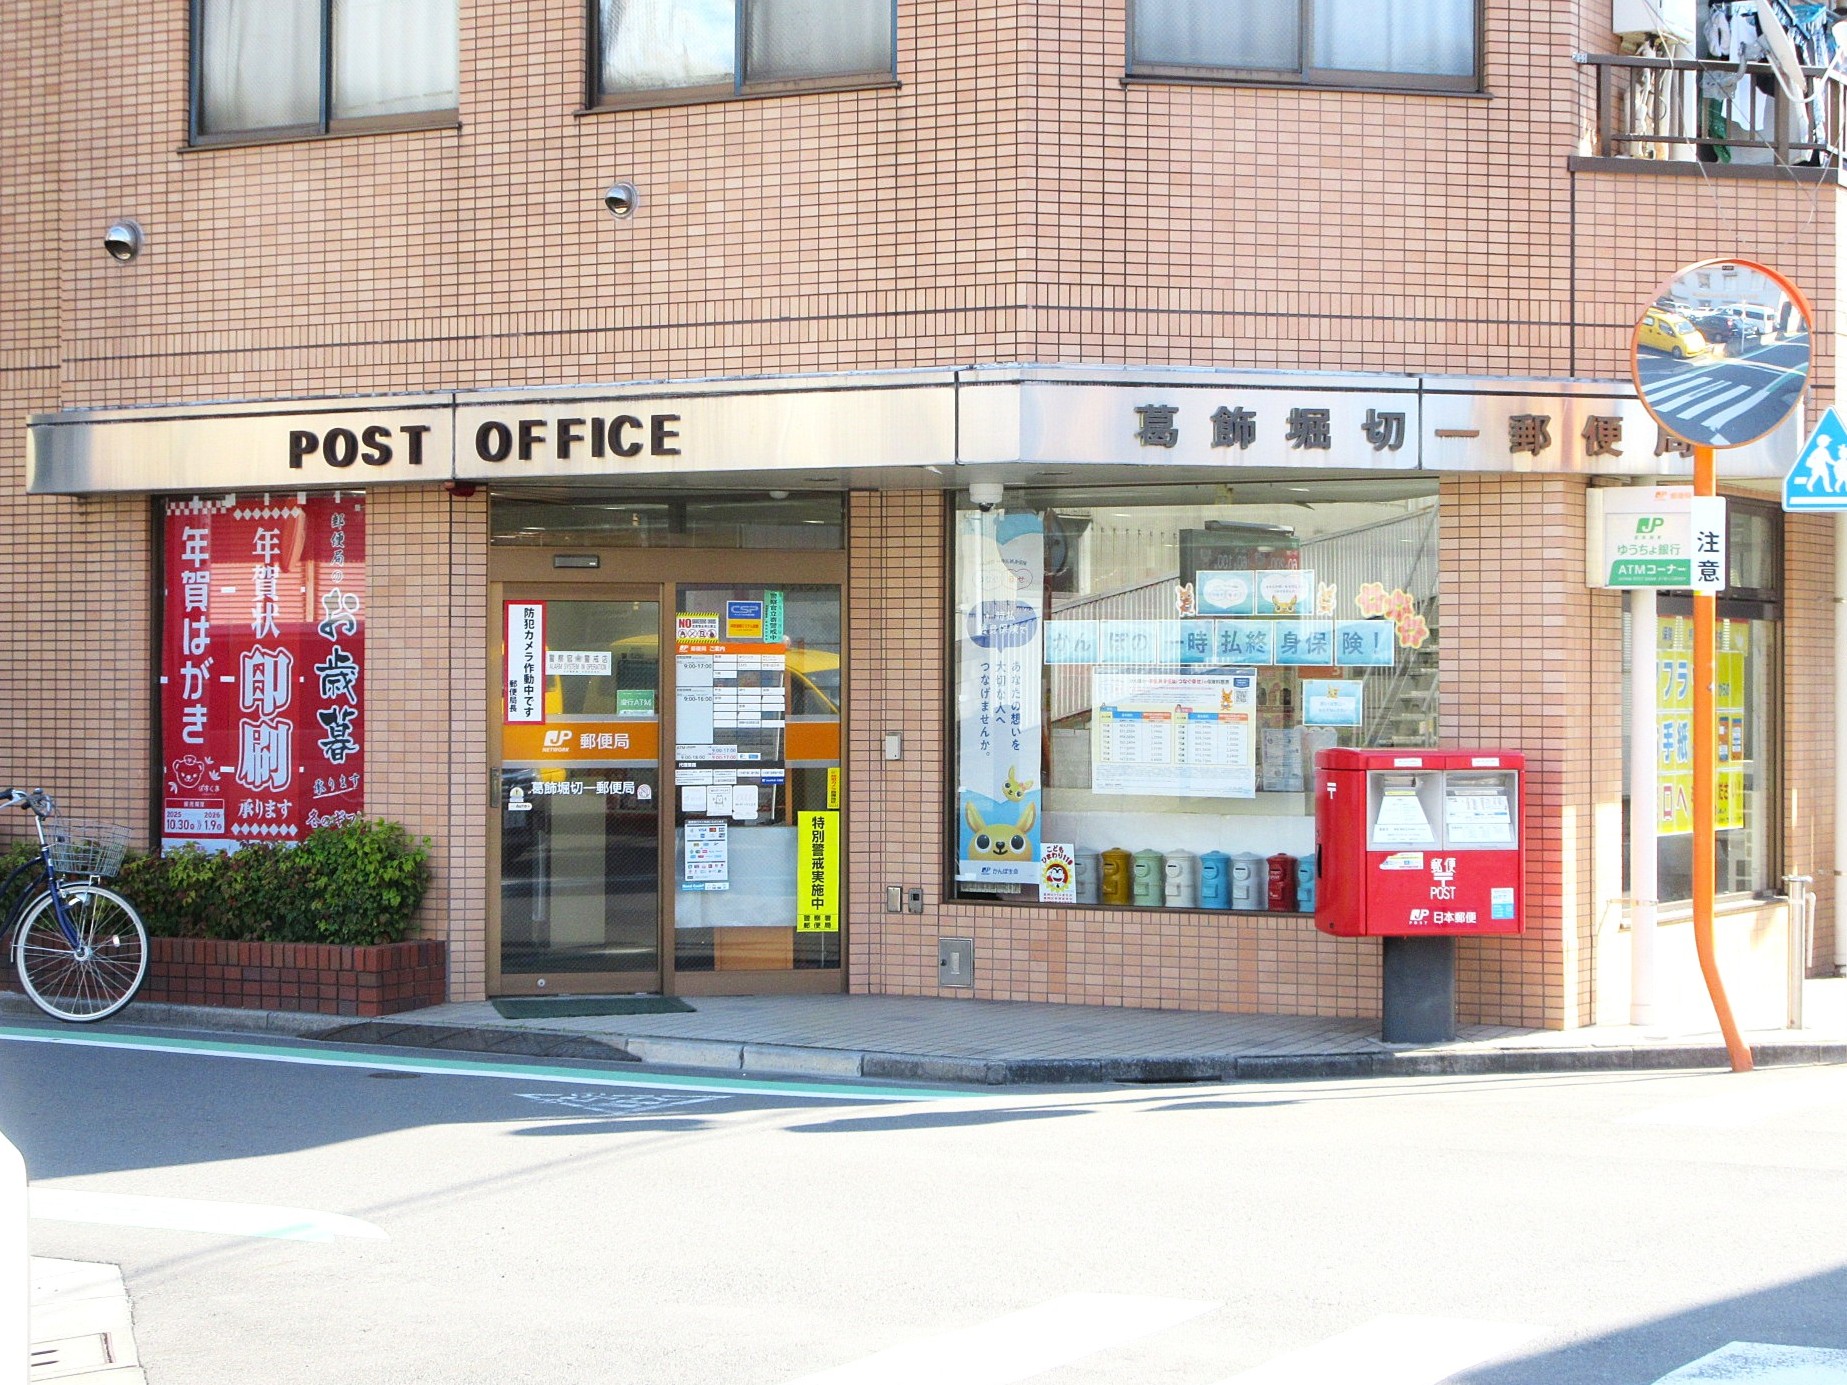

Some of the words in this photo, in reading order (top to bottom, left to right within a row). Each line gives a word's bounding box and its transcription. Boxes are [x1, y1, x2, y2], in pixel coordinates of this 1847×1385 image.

[289, 425, 430, 469] POST
[475, 413, 682, 462] OFFICE
[1635, 517, 1664, 534] JP
[329, 512, 346, 584] 郵便局の
[1617, 544, 1681, 556] ゆうちょ銀行
[1697, 531, 1720, 582] 注意
[251, 526, 281, 639] 年賀状
[1618, 564, 1686, 575] ATMコーナー
[679, 618, 692, 629] NO
[731, 605, 759, 614] CSP
[180, 526, 214, 744] 年賀はがき
[314, 587, 360, 764] お歳暮
[523, 607, 535, 718] 防犯カメラ作動中です
[509, 680, 518, 713] 郵便局長
[979, 662, 990, 756] つなげませんか。
[995, 661, 1006, 724] 大切な人へ
[1011, 661, 1021, 751] あなたの想いを
[236, 644, 293, 792] 印刷
[544, 730, 573, 747] JP
[580, 733, 630, 750] 郵便局
[531, 781, 635, 795] 葛飾堀切一郵便局
[238, 798, 292, 819] 承ります
[811, 816, 824, 910] 特別警戒実施中
[1047, 845, 1064, 853] こども
[1430, 857, 1456, 873] 郵便
[1430, 886, 1456, 900] POST
[1410, 909, 1430, 920] JP
[1433, 911, 1477, 924] 日本郵便
